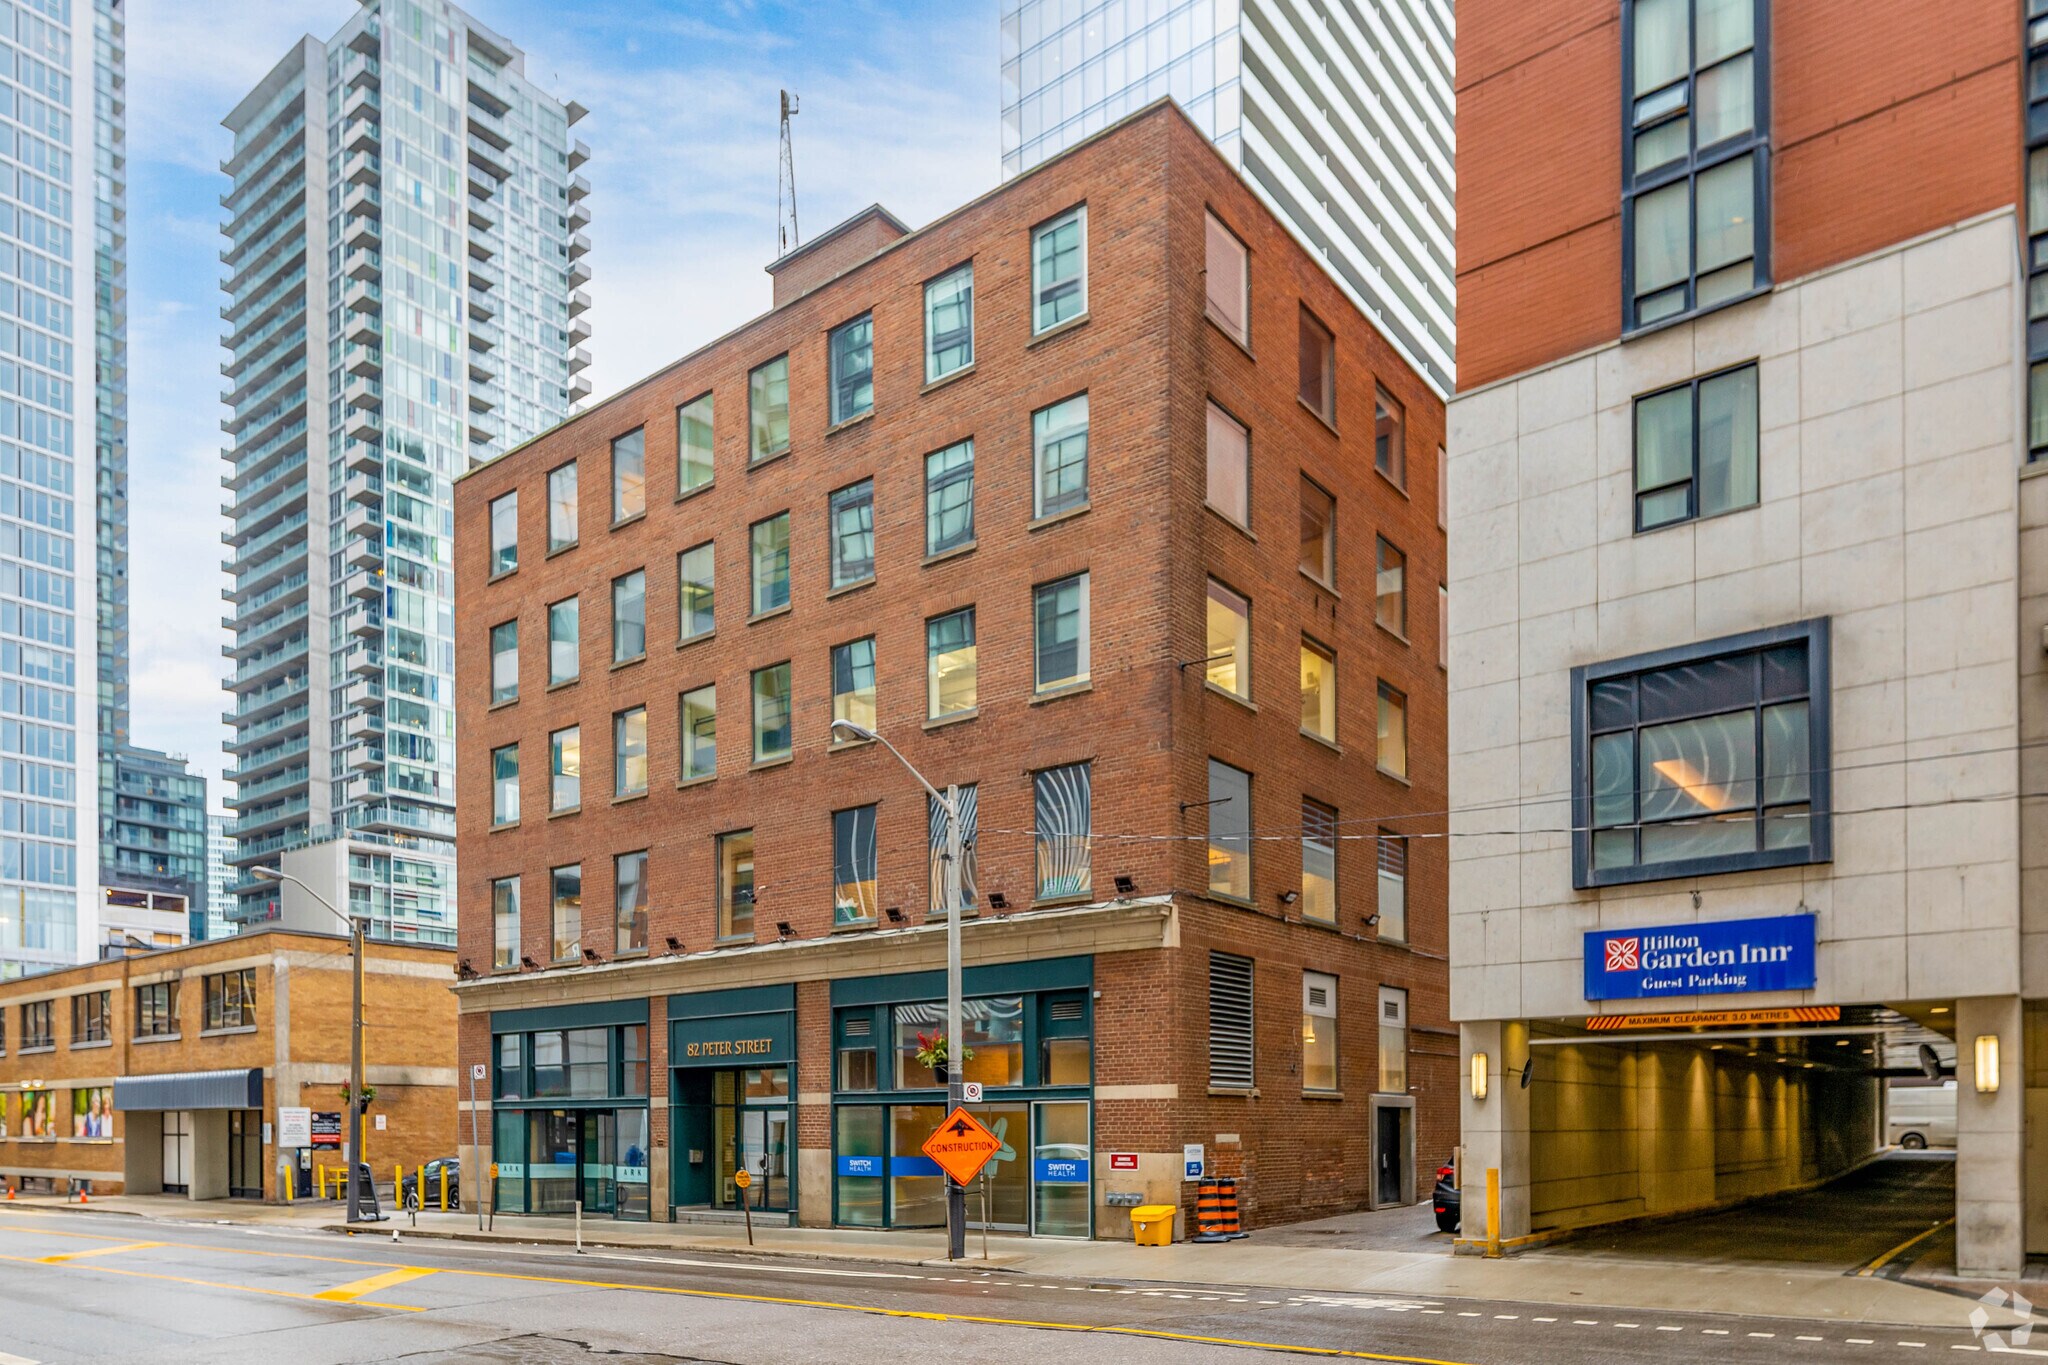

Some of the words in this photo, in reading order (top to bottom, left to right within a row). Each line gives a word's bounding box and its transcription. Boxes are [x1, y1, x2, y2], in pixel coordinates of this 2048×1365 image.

[1643, 935, 1699, 951] Hilton
[1641, 947, 1736, 970] Garden
[1740, 943, 1789, 964] Inn
[1641, 976, 1683, 990] Guest
[1688, 972, 1748, 987] Parking
[1628, 1016, 1671, 1026] MAXIMUM
[1673, 1013, 1728, 1024] CLEARANCE
[1732, 1012, 1747, 1022] 3.0
[1750, 1011, 1790, 1020] METRES
[687, 1043, 700, 1057] 82
[702, 1041, 732, 1056] PETER
[735, 1039, 772, 1055] STREET
[930, 1141, 993, 1154] CONSTRUCTION
[849, 1159, 872, 1167] SWITCH
[1047, 1163, 1076, 1171] SWITCH
[623, 1168, 642, 1176] ARK
